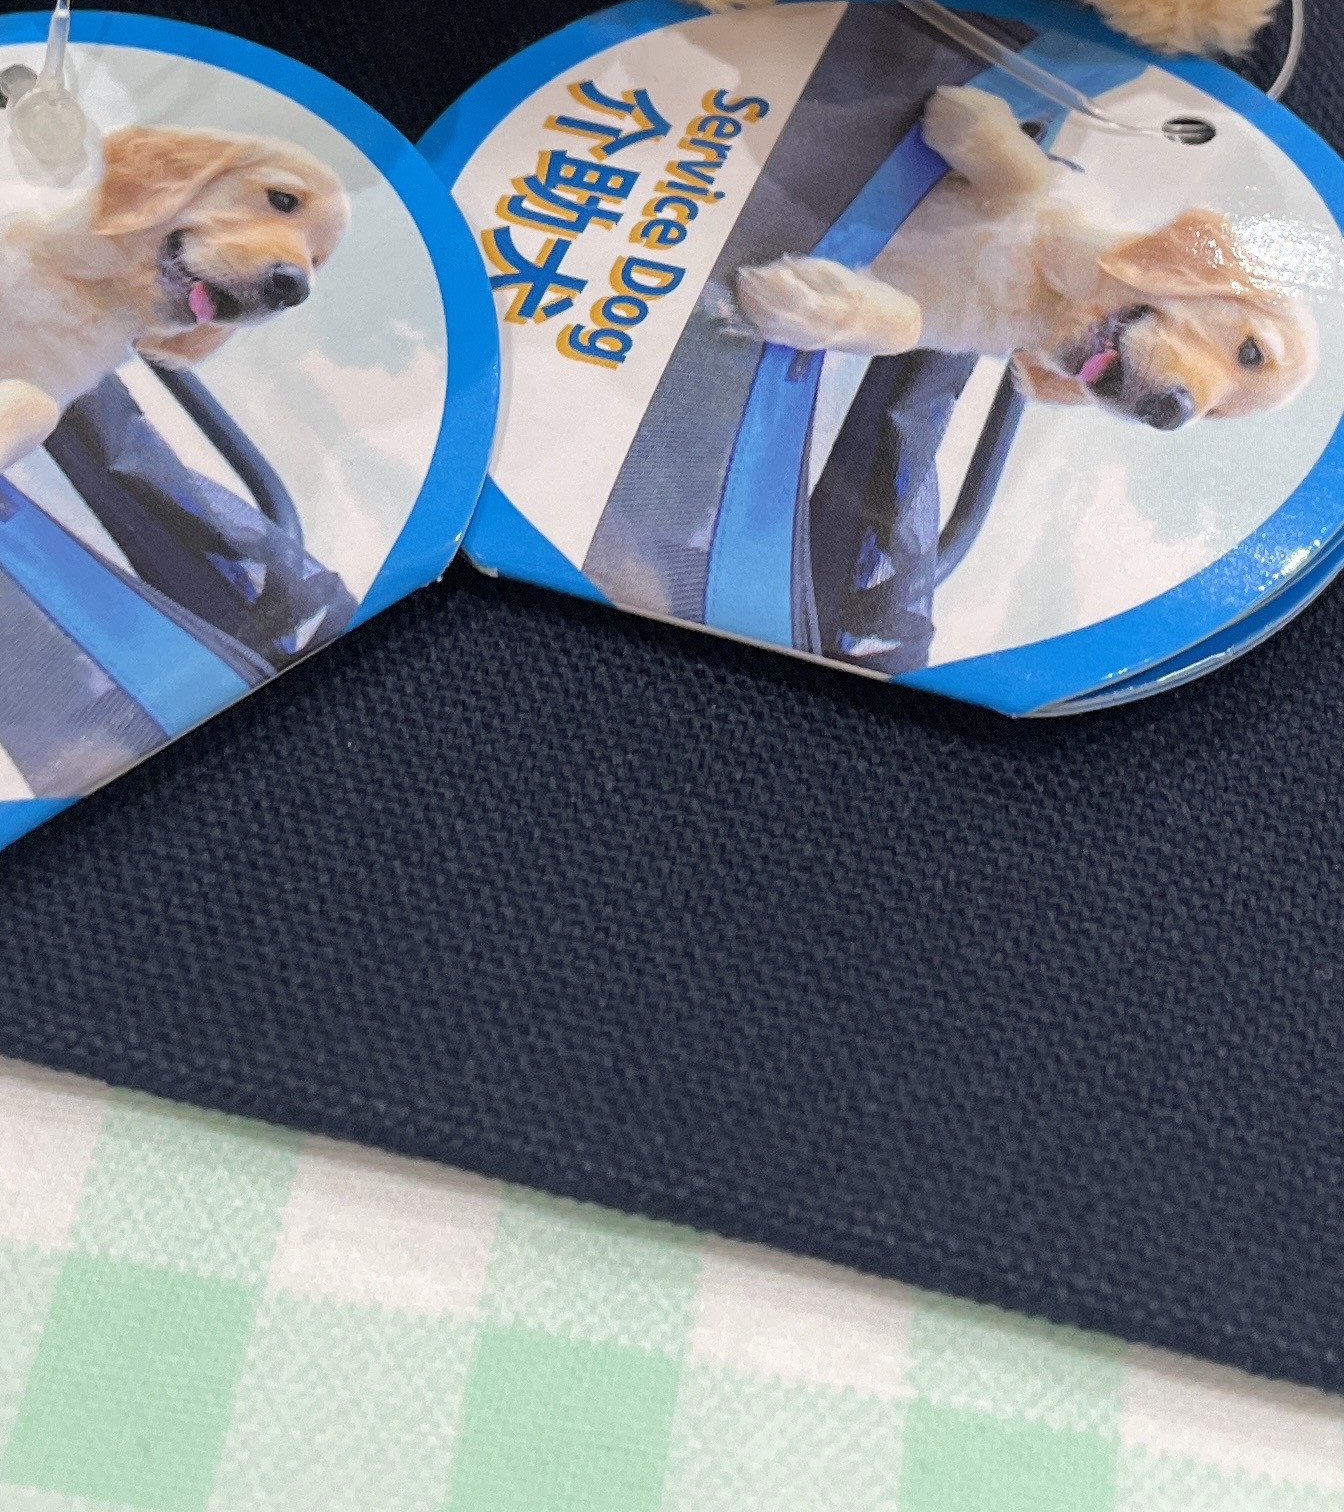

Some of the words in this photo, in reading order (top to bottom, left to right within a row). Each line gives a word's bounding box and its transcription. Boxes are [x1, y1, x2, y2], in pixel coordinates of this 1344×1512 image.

[480, 78, 673, 326] 介助犬
[628, 88, 770, 251] Service
[555, 255, 687, 370] Dog
